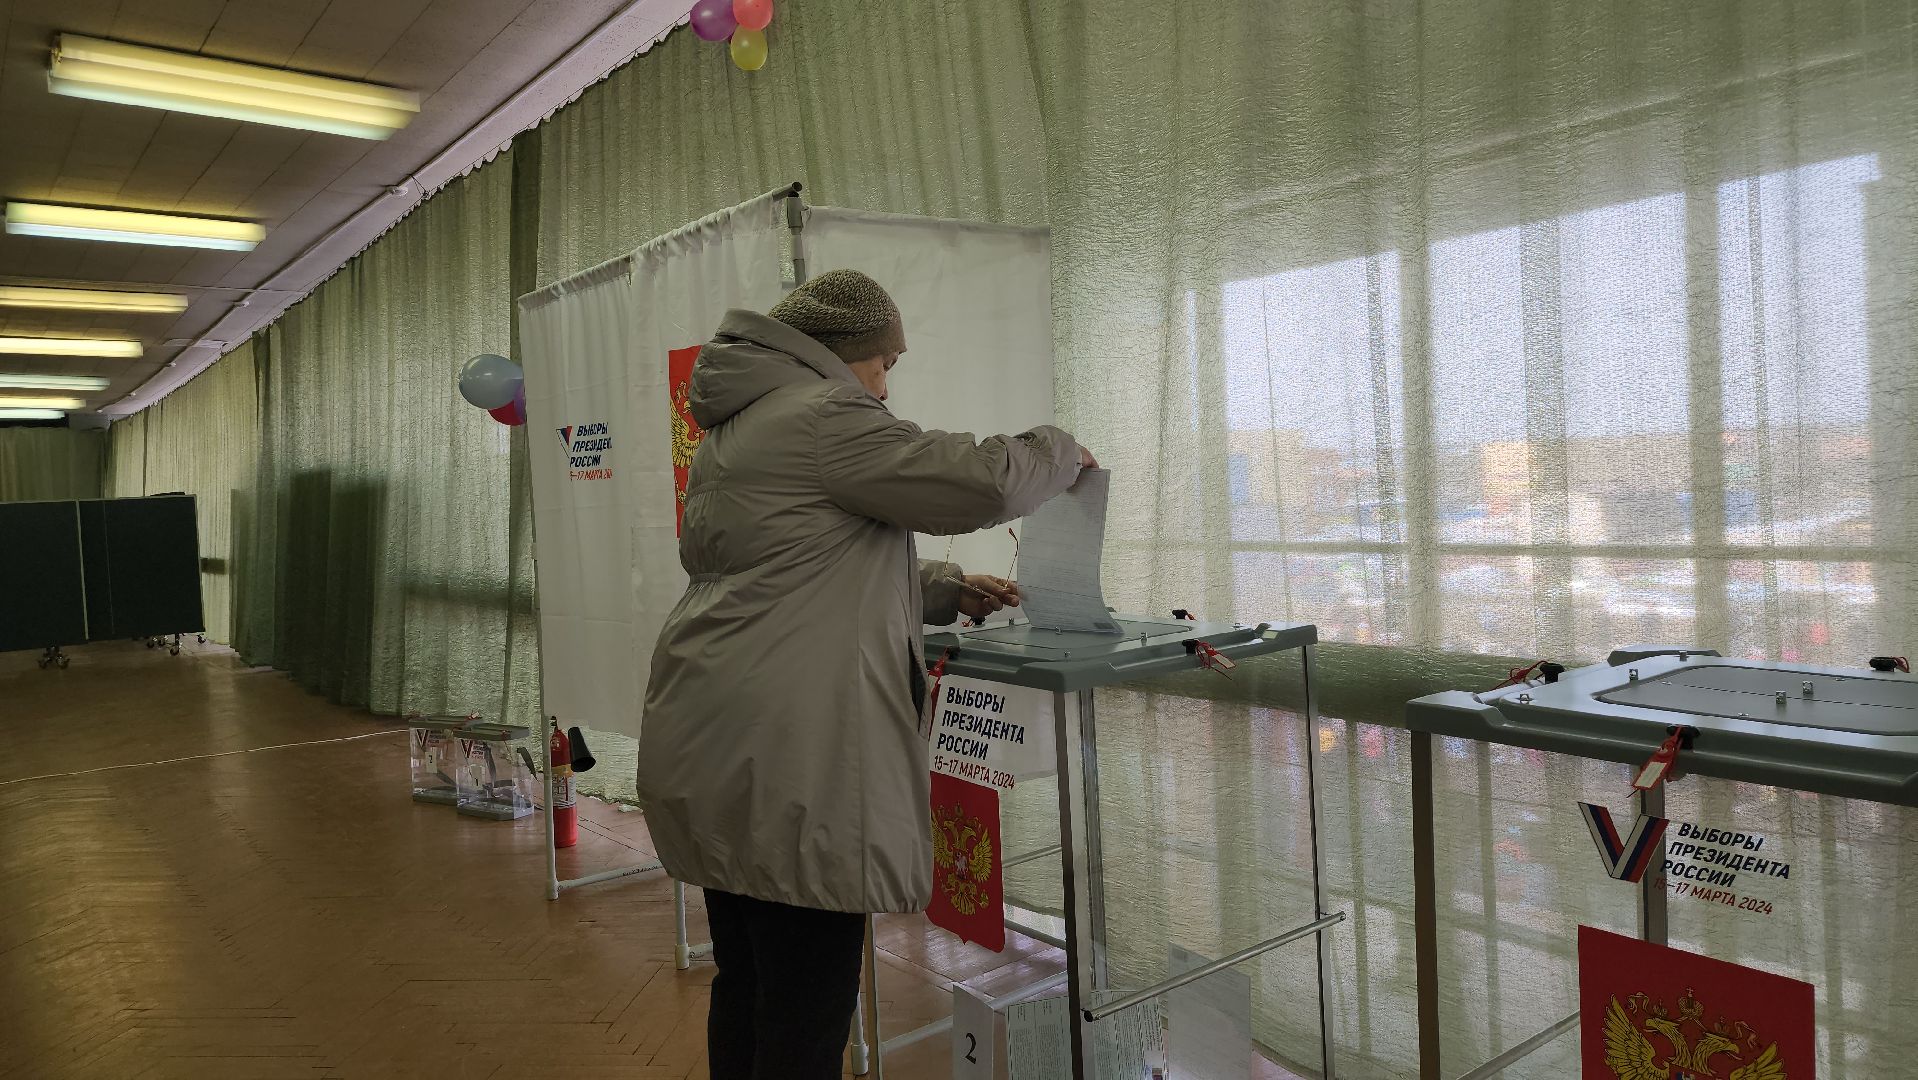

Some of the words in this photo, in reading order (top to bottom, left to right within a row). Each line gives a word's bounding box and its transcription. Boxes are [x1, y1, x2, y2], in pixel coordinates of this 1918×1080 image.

[577, 422, 608, 436] ВЫБОРЫ
[570, 454, 601, 467] РОССИИ
[947, 687, 1005, 713] ВЫБОРЫ
[942, 710, 1025, 744] ПРЕЗИДЕНТА
[937, 733, 989, 761] РОССИИ
[959, 762, 990, 783] МАРТА
[992, 771, 1015, 789] 2024
[1677, 822, 1764, 852] ВЫБОРЫ
[1659, 859, 1736, 888] РОССИИ
[1668, 841, 1791, 880] ПРЕЗИДЕНТА
[1689, 885, 1736, 908] МАРТА
[1737, 896, 1773, 915] 2024
[965, 1032, 977, 1065] 2
